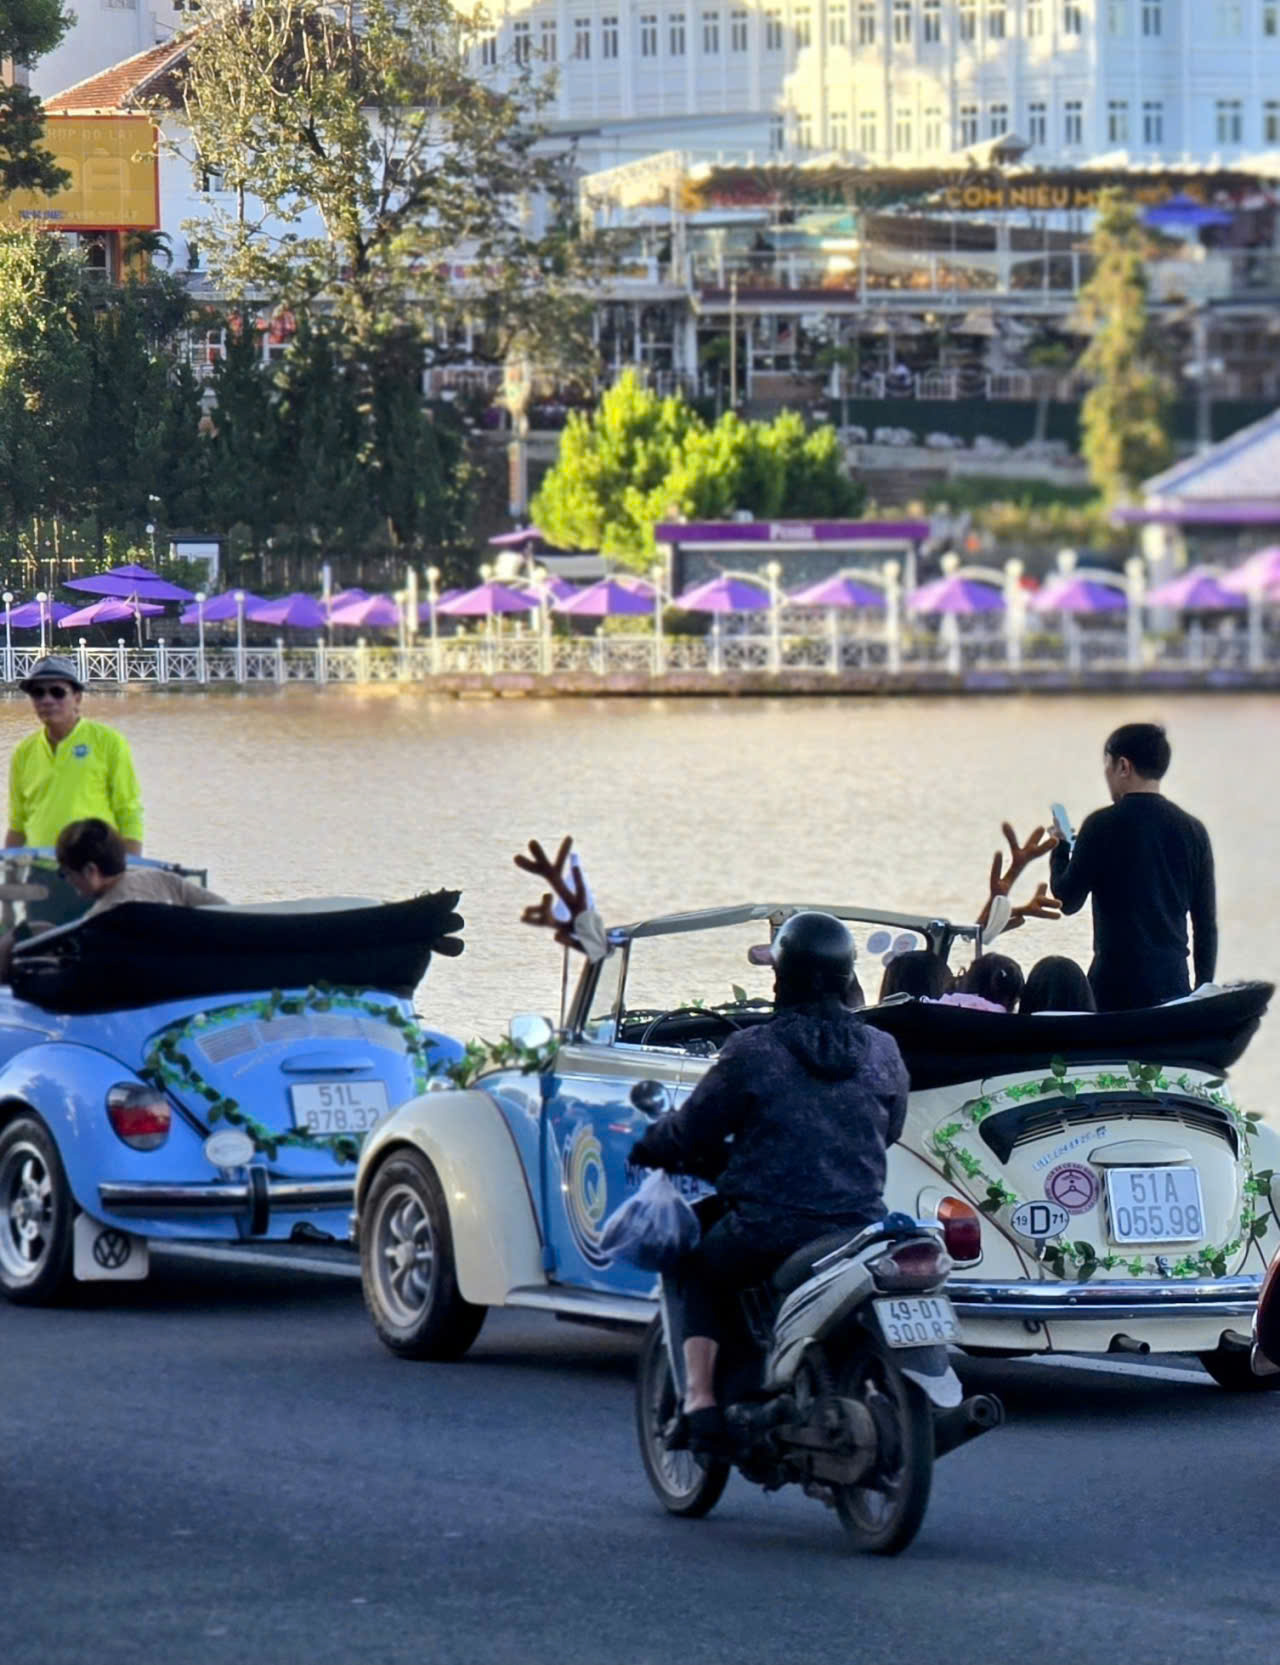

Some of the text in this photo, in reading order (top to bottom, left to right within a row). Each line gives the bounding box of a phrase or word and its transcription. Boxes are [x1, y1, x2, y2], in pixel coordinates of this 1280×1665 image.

[318, 1085, 361, 1106] 51L
[1130, 1173, 1178, 1204] 51A
[1030, 1206, 1050, 1235] D
[1116, 1205, 1200, 1236] 055.98
